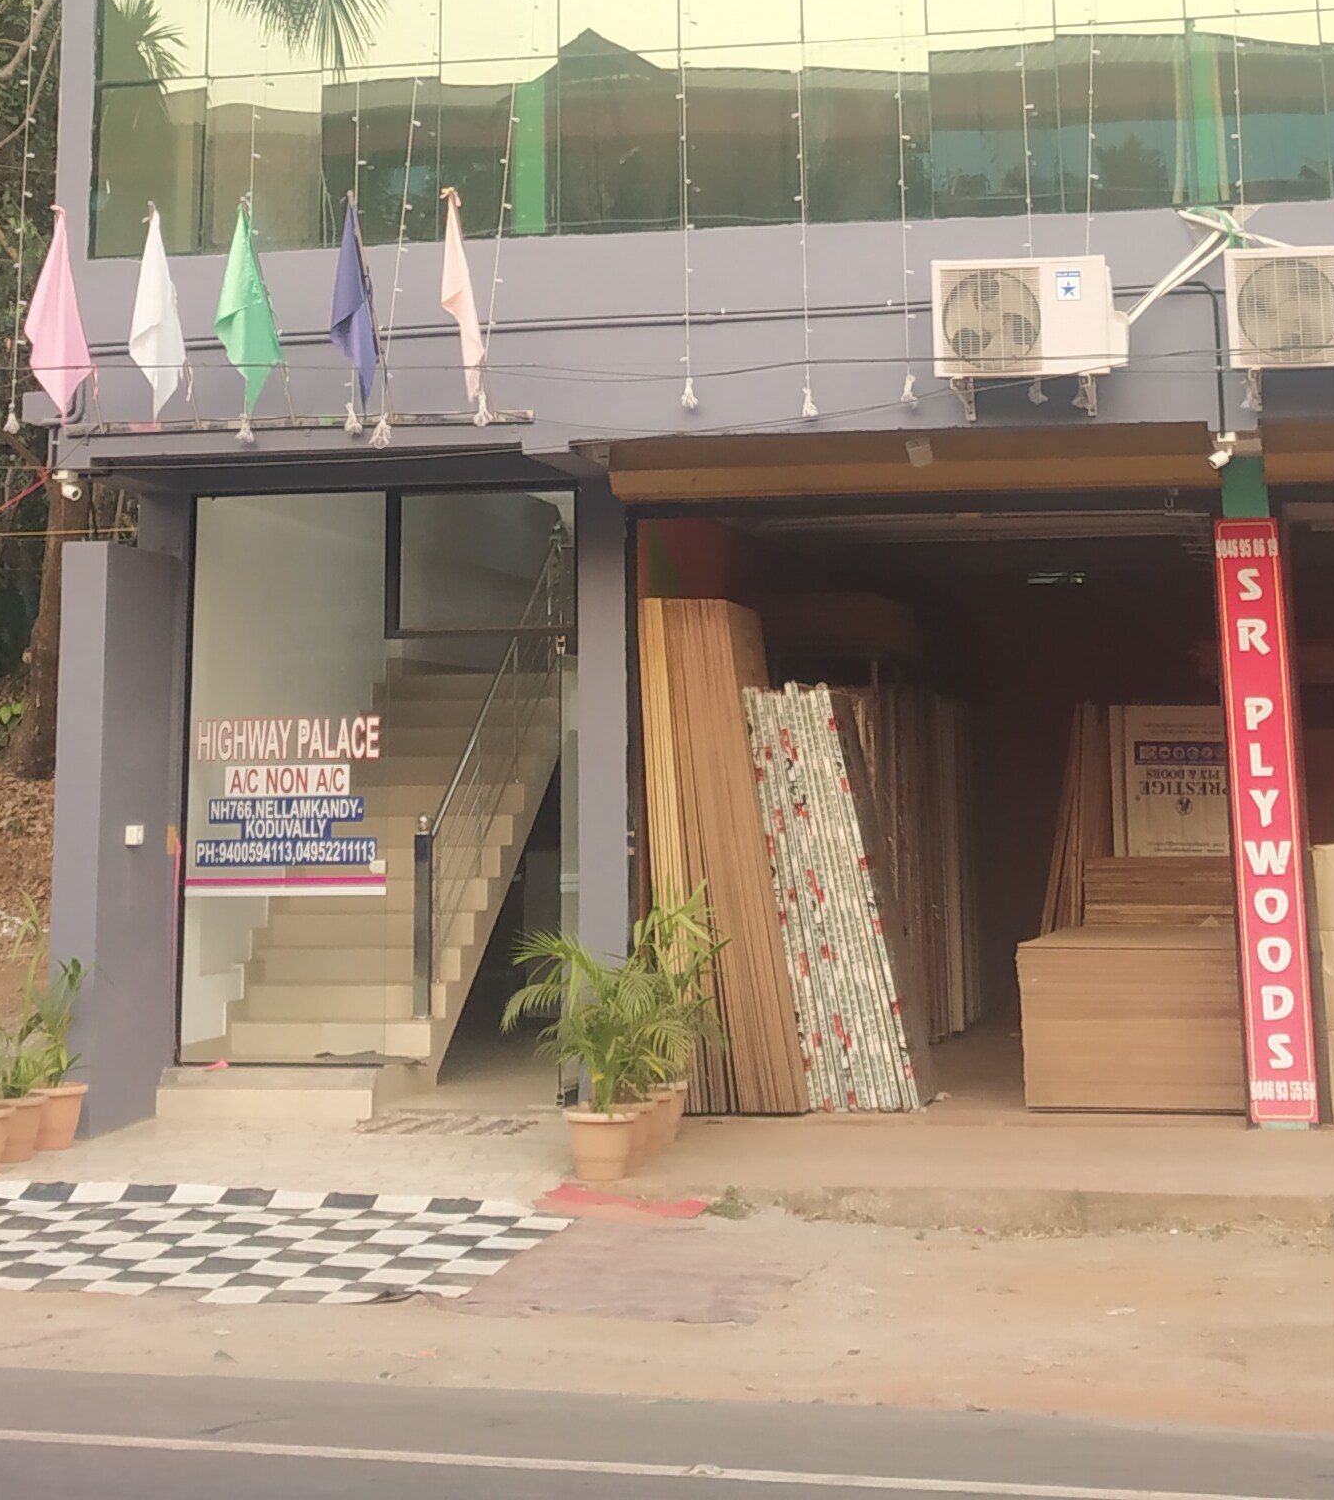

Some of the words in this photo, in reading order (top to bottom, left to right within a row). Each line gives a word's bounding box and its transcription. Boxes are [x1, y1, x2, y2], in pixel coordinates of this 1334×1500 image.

[1239, 539, 1252, 558] 95
[1267, 538, 1279, 557] 19
[1236, 568, 1271, 655] SR
[197, 718, 293, 762] HIGHWAY
[297, 715, 381, 760] PALACE
[230, 768, 259, 794] A/C
[266, 767, 309, 794] NON
[316, 767, 345, 793] A/C
[1146, 769, 1185, 780] DOORS
[245, 819, 327, 839] KODUVALLY
[1244, 697, 1295, 1069] PLYWOODS
[1275, 1080, 1288, 1101] 93
[1289, 1081, 1302, 1101] 55
